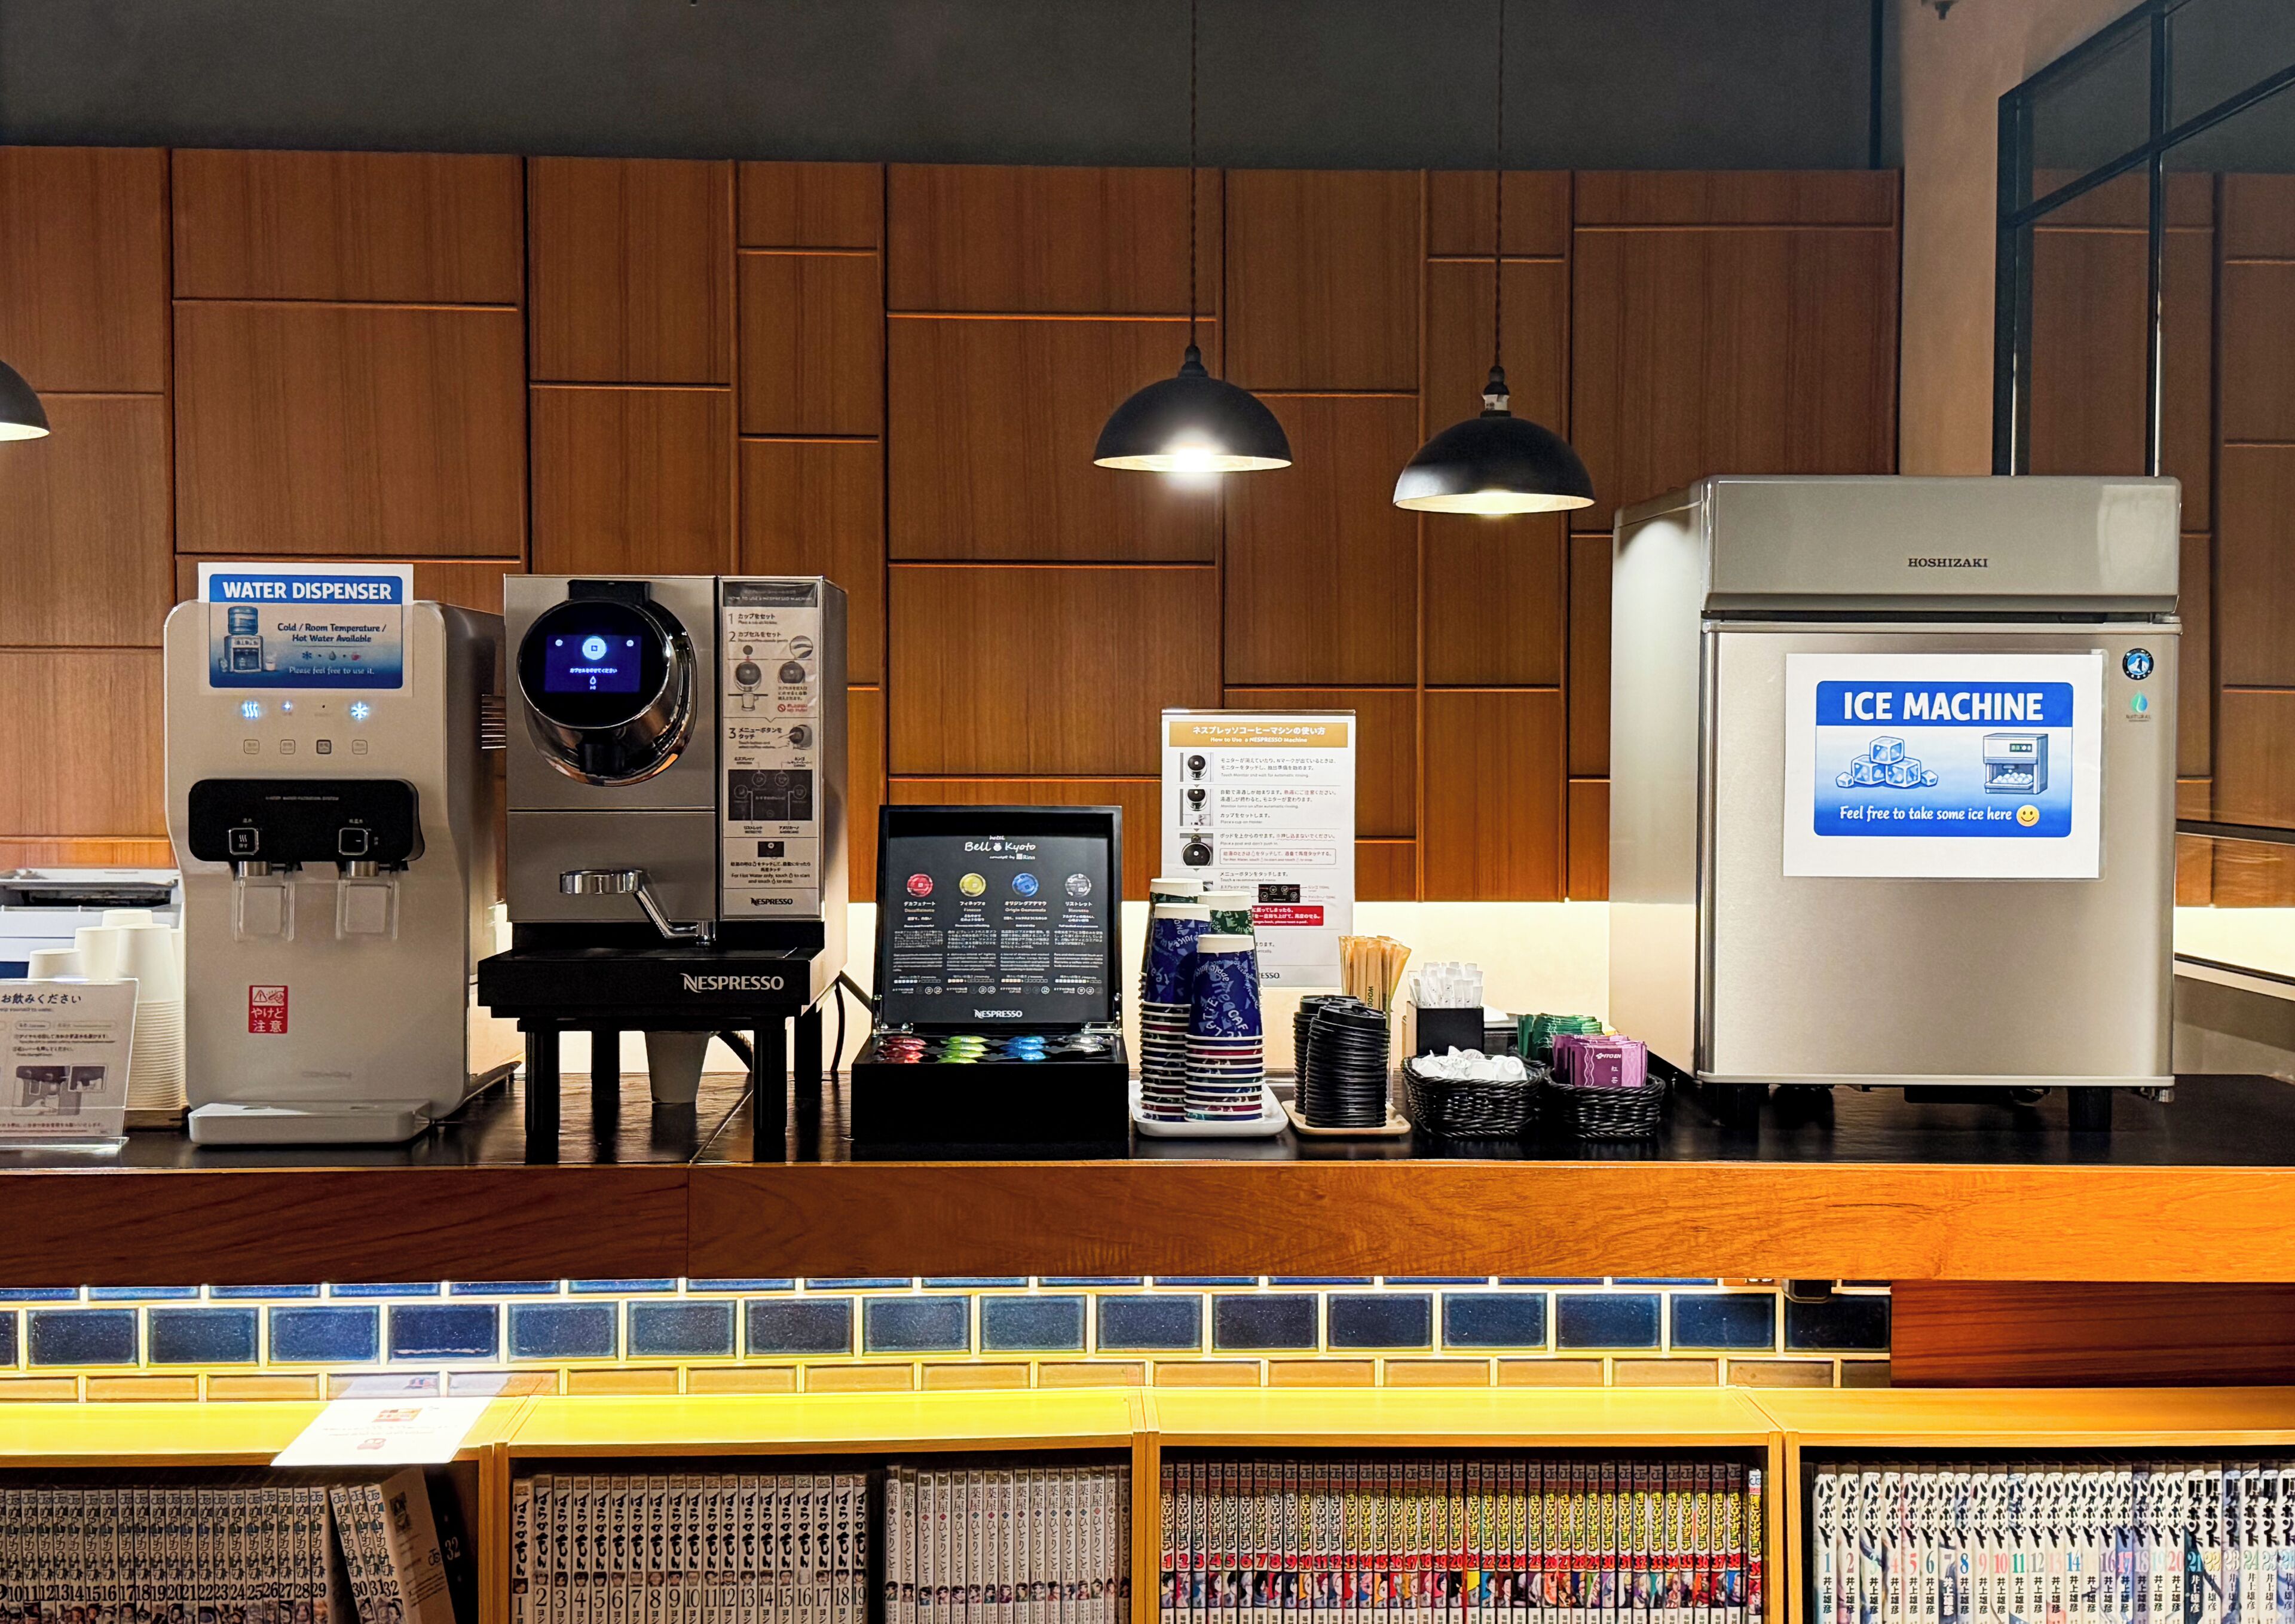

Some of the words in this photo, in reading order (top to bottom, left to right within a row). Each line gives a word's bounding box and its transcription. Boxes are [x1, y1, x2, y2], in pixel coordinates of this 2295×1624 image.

[1908, 558, 1988, 567] HOSHIZAKI
[223, 582, 286, 598] WATER
[293, 583, 391, 600] DISPENSER
[729, 613, 733, 624] 1
[331, 624, 380, 633] Temperature
[729, 632, 736, 642] 2
[1844, 692, 1892, 720] ICE
[1903, 692, 2044, 721] MACHINE
[729, 728, 736, 739] 3
[1193, 726, 1326, 735] ネスプレッソコーヒーマシンの使い方
[1840, 805, 1863, 820] Feel
[1866, 805, 1890, 822] free
[1893, 807, 1905, 819] to
[1909, 806, 1933, 820] take
[1936, 810, 1965, 821] some
[1968, 807, 1984, 820] ice
[1987, 806, 2012, 820] here
[965, 842, 991, 851] Bell
[1005, 842, 1036, 852] Kyoto
[1211, 965, 1229, 981] apple
[680, 972, 785, 993] NESPRESSO
[1, 993, 81, 1004] お飲みください
[251, 1008, 284, 1019] やけど
[974, 1009, 1023, 1019] NESPRESSO
[253, 1020, 283, 1032] 注意
[1164, 1554, 1172, 1569] 1
[1210, 1553, 1221, 1568] 4
[1241, 1553, 1252, 1568] 6
[1315, 1555, 1328, 1570] 11
[1375, 1555, 1388, 1569] 15
[1498, 1555, 1511, 1568] 23
[1603, 1555, 1615, 1569] 30
[1696, 1555, 1709, 1569] 36
[1825, 1552, 1830, 1573] 1
[1846, 1553, 1854, 1573] 2
[1910, 1553, 1917, 1574] 5
[1960, 1553, 1969, 1574] 8
[1994, 1553, 2008, 1573] 10
[2012, 1553, 2025, 1573] 11
[2067, 1550, 2080, 1572] 14
[2118, 1552, 2132, 1574] 17
[2168, 1551, 2184, 1571] 20
[2204, 1551, 2221, 1572] 22
[905, 1572, 911, 1581] 2
[1034, 1571, 1044, 1580] 10
[39, 1585, 54, 1601] 12
[70, 1585, 85, 1601] 14
[120, 1585, 136, 1601] 17
[152, 1585, 166, 1601] 19
[198, 1585, 213, 1600] 22
[247, 1585, 262, 1600] 25
[295, 1583, 310, 1598] 28
[594, 1589, 605, 1608] 5
[631, 1589, 642, 1608] 7
[669, 1589, 680, 1607] 9
[721, 1588, 735, 1607] 12
[760, 1588, 773, 1607] 14
[836, 1586, 849, 1606] 18
[1823, 1577, 1832, 1614] 井上雄彦
[1846, 1577, 1855, 1614] 井上雄彦
[2068, 1576, 2078, 1612] 井上雄彦
[2172, 1575, 2181, 1611] 井上雄彦
[2247, 1573, 2256, 1610] 井上雄彦
[555, 1590, 567, 1608] 3
